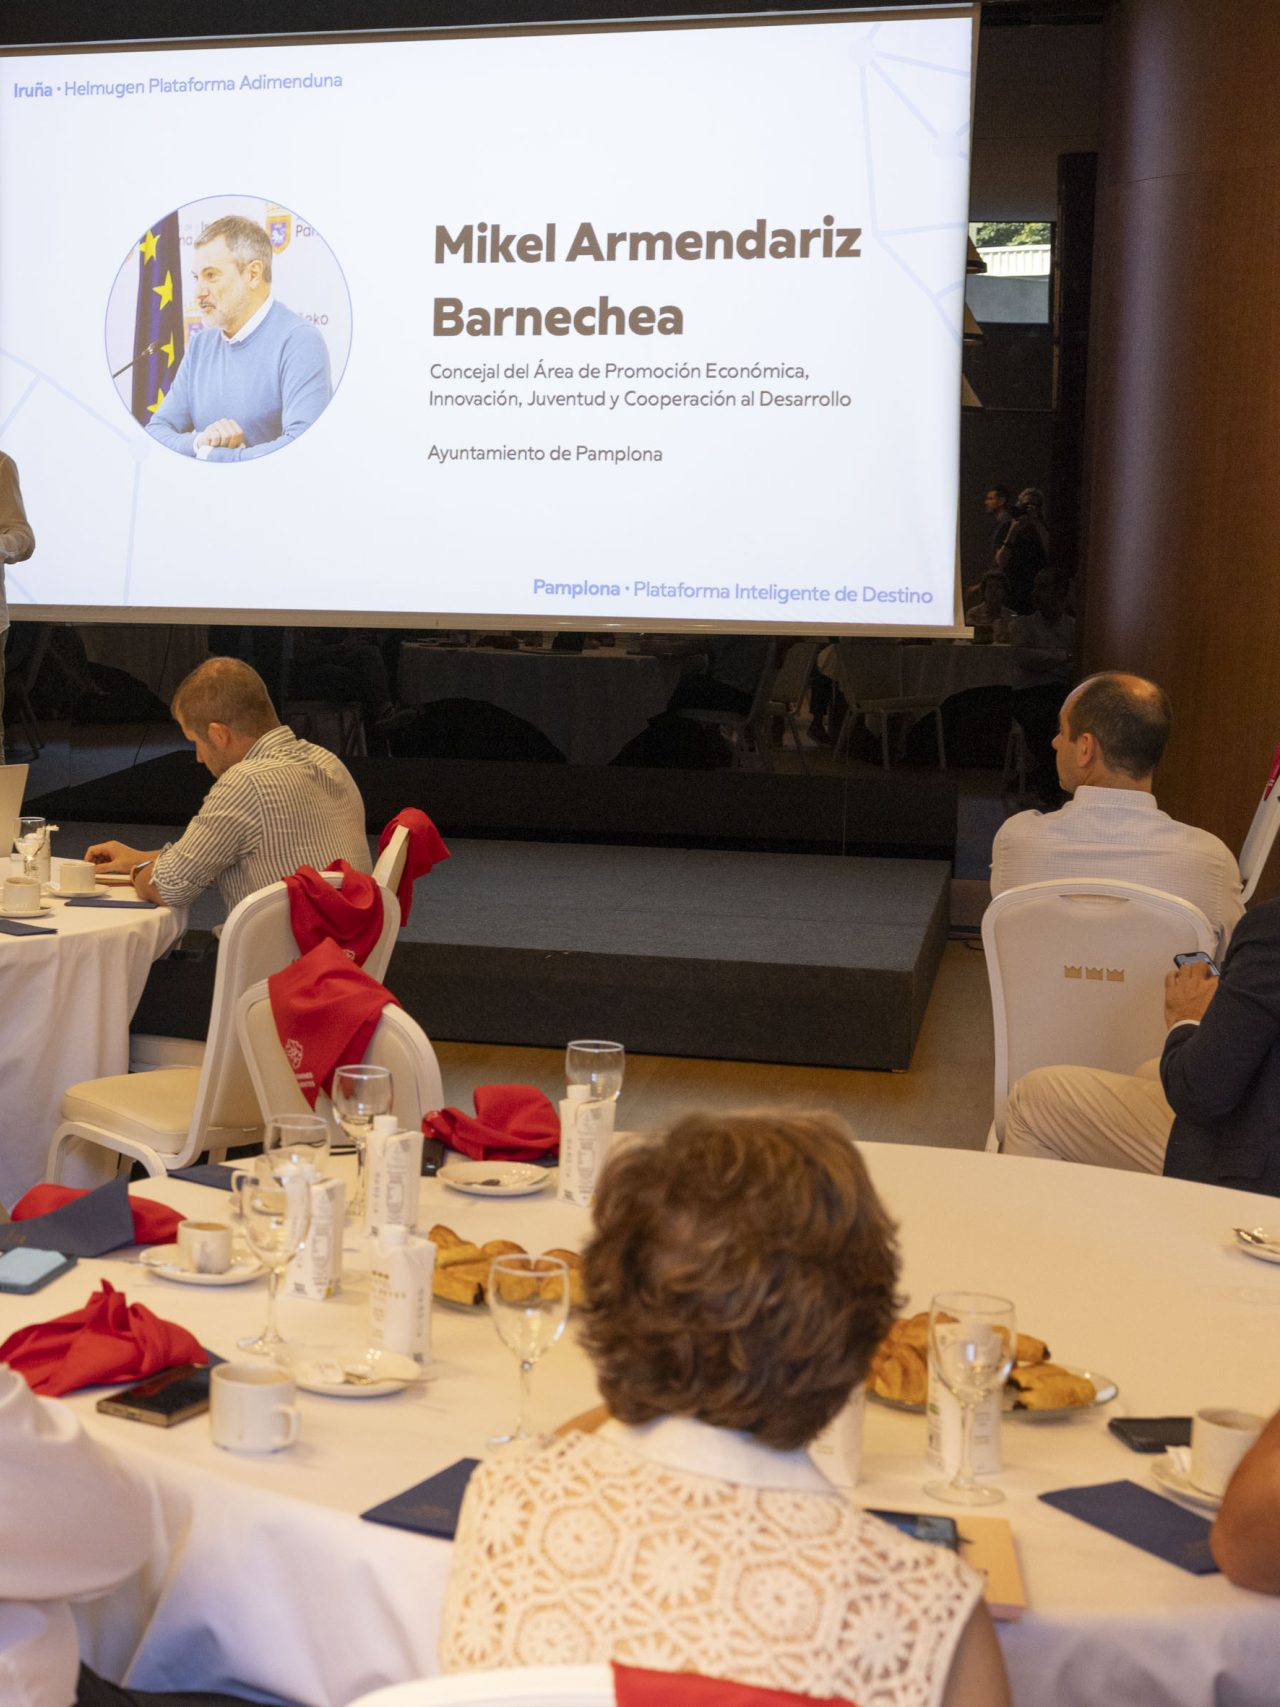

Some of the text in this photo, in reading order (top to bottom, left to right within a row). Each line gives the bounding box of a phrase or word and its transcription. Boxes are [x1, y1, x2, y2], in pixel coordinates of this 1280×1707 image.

[13, 72, 343, 99] Iruña Helmugen Plataforma Adimenduna
[434, 214, 863, 265] Mikel Armendariz
[432, 295, 684, 337] Barnechea
[429, 358, 810, 384] Concejal del Área de Promoción Económica,
[429, 389, 852, 411] Innovación, Juventud y Cooperación al Desarrollo
[427, 444, 663, 466] Ayuntamiento de Pamplona
[533, 578, 934, 605] Pamplona Plataforma Inteligente de Destino
